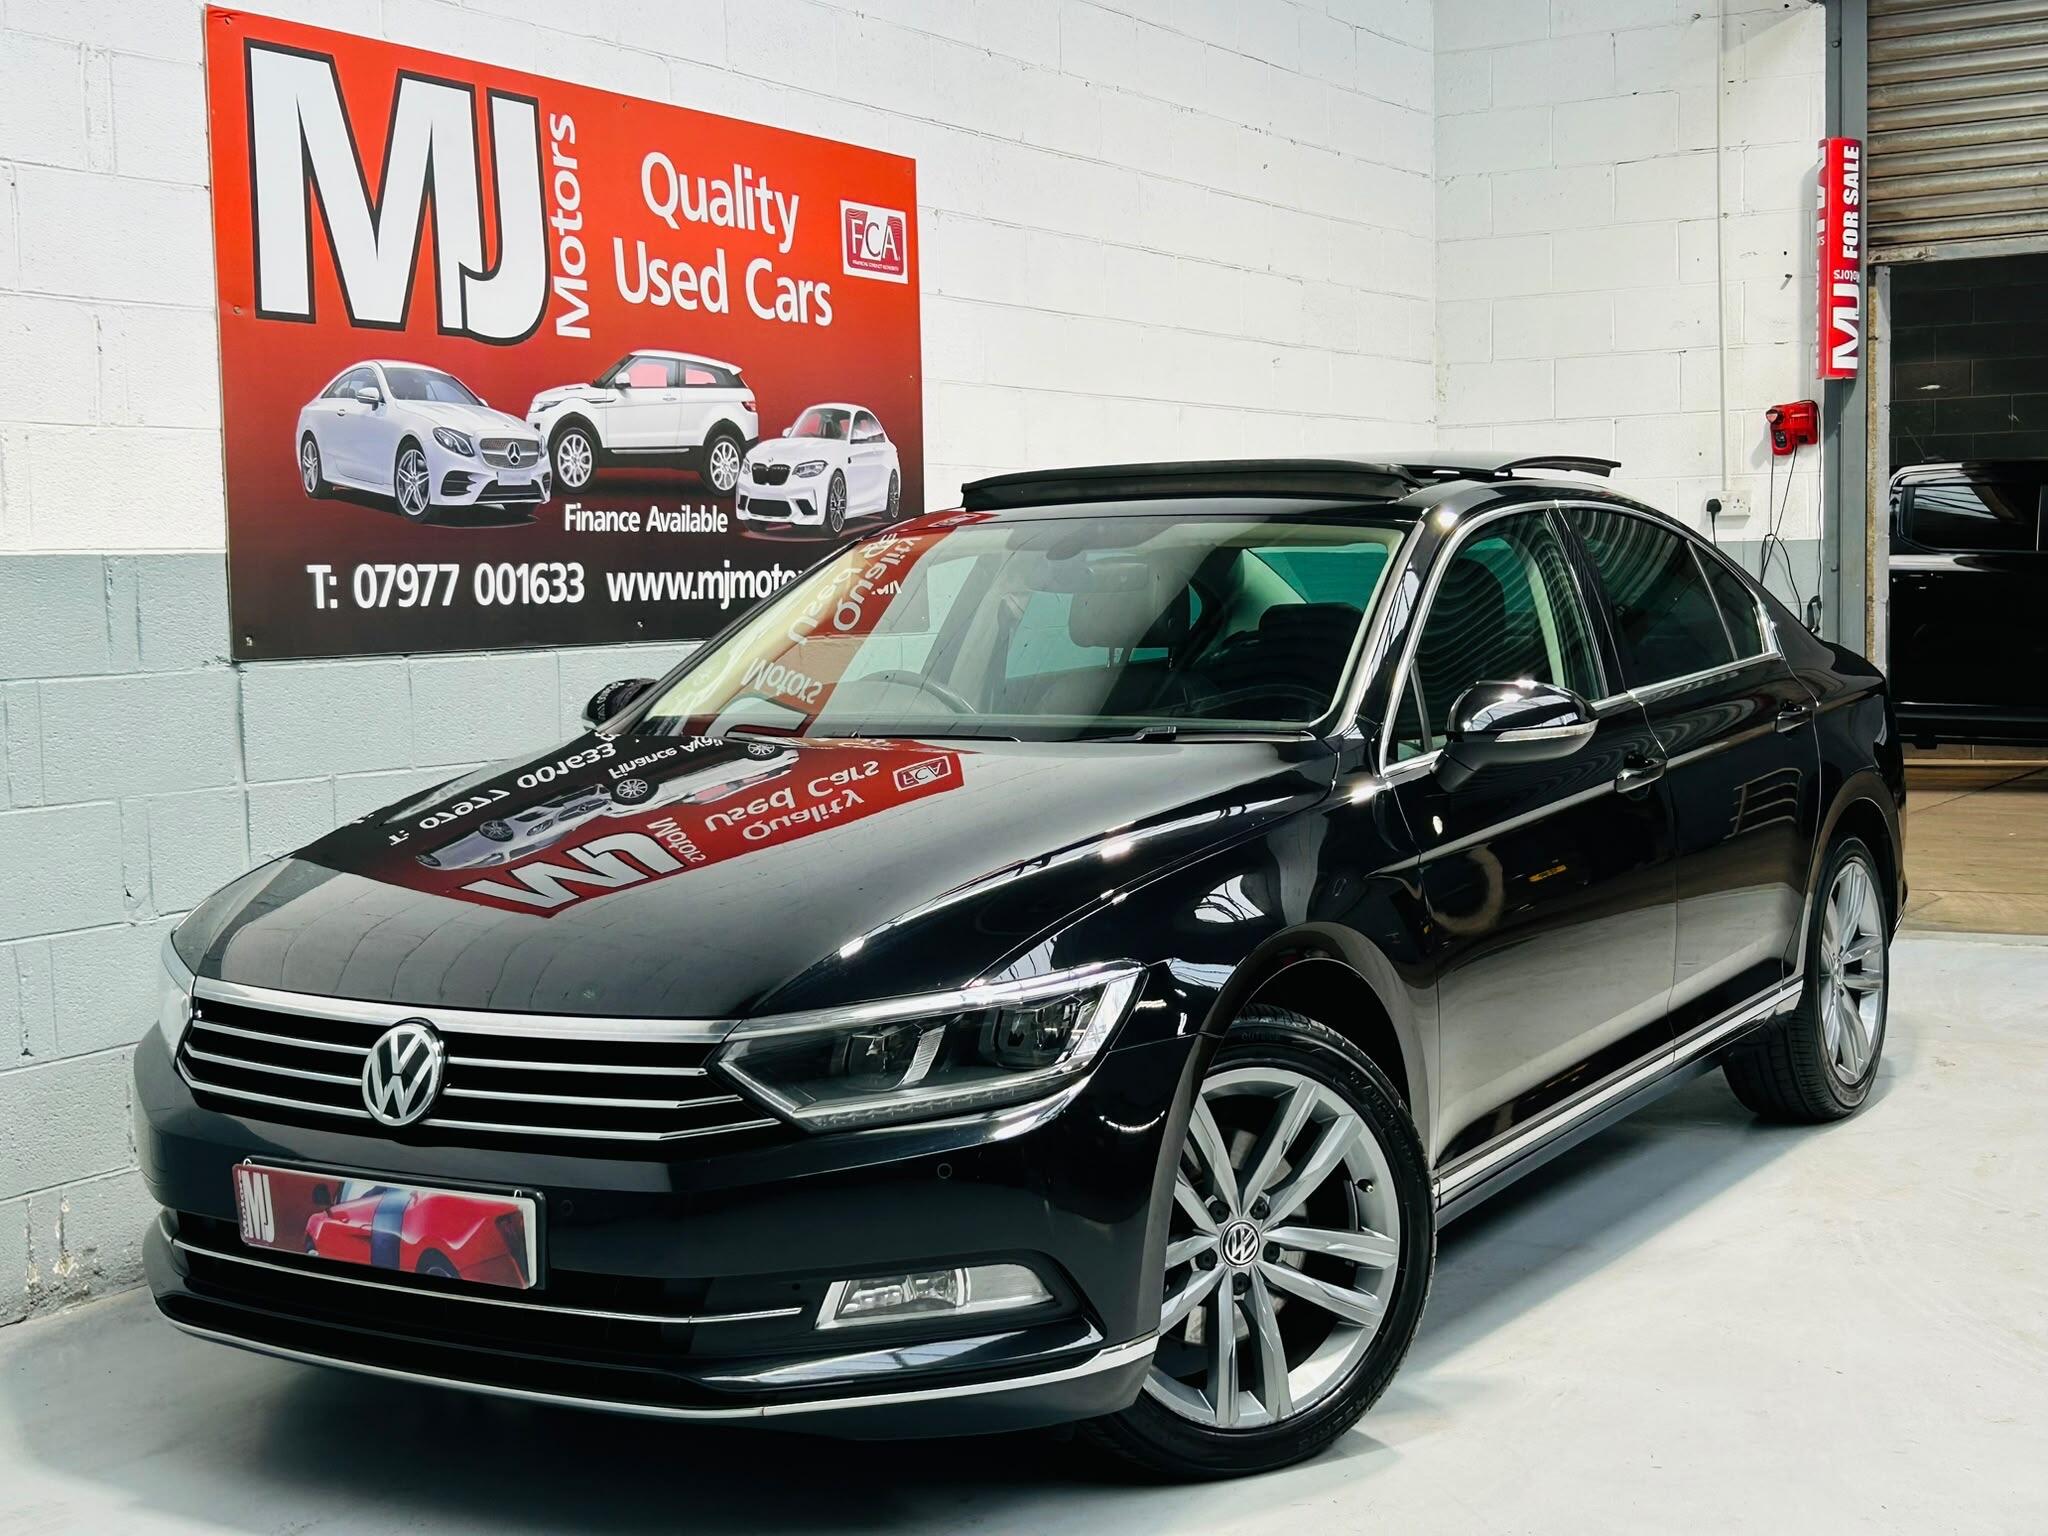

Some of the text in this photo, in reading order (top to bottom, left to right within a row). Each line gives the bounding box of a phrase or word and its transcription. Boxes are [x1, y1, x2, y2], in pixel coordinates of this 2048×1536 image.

[244, 38, 550, 346] MJ
[550, 112, 591, 340] Motors
[641, 151, 800, 254] Quality
[1843, 145, 1860, 259] FOR SALE
[612, 236, 834, 326] Used Cars
[851, 218, 900, 261] FCA
[1832, 283, 1860, 370] MJ
[564, 503, 729, 534] Finance Available
[306, 564, 338, 609] T:
[353, 564, 458, 609] 07977
[473, 562, 586, 606] 001633
[606, 560, 804, 610] www.mjmoto
[241, 1169, 275, 1243] MJ
